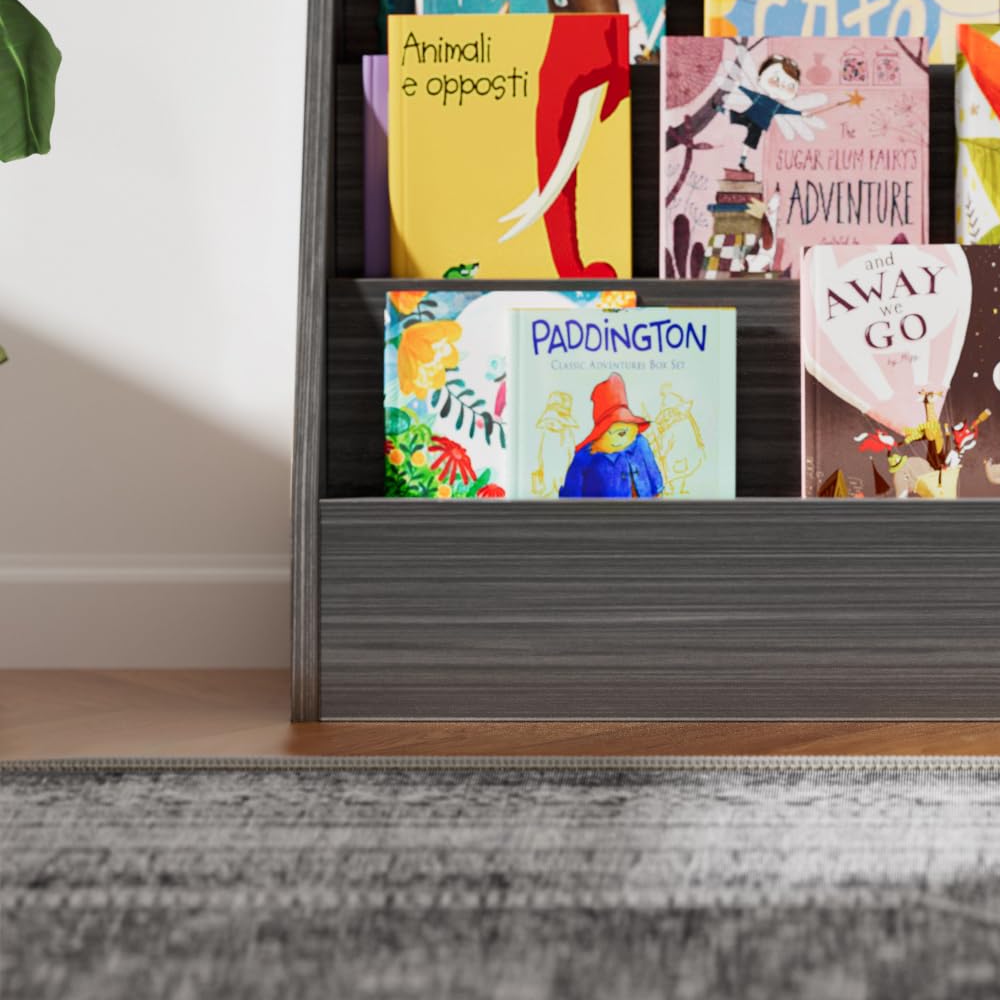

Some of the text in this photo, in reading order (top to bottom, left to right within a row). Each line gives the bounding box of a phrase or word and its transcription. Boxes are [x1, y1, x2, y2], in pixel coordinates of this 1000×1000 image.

[401, 31, 492, 67] Animali
[401, 66, 529, 107] e opposti
[775, 148, 824, 171] SUGAR
[827, 147, 866, 171] PLUM
[786, 178, 914, 227] ADVENTURE
[864, 252, 895, 272] and
[825, 265, 949, 321] AWAY
[880, 302, 904, 317] we
[531, 317, 708, 356] PADDINGTON
[863, 312, 928, 350] GO
